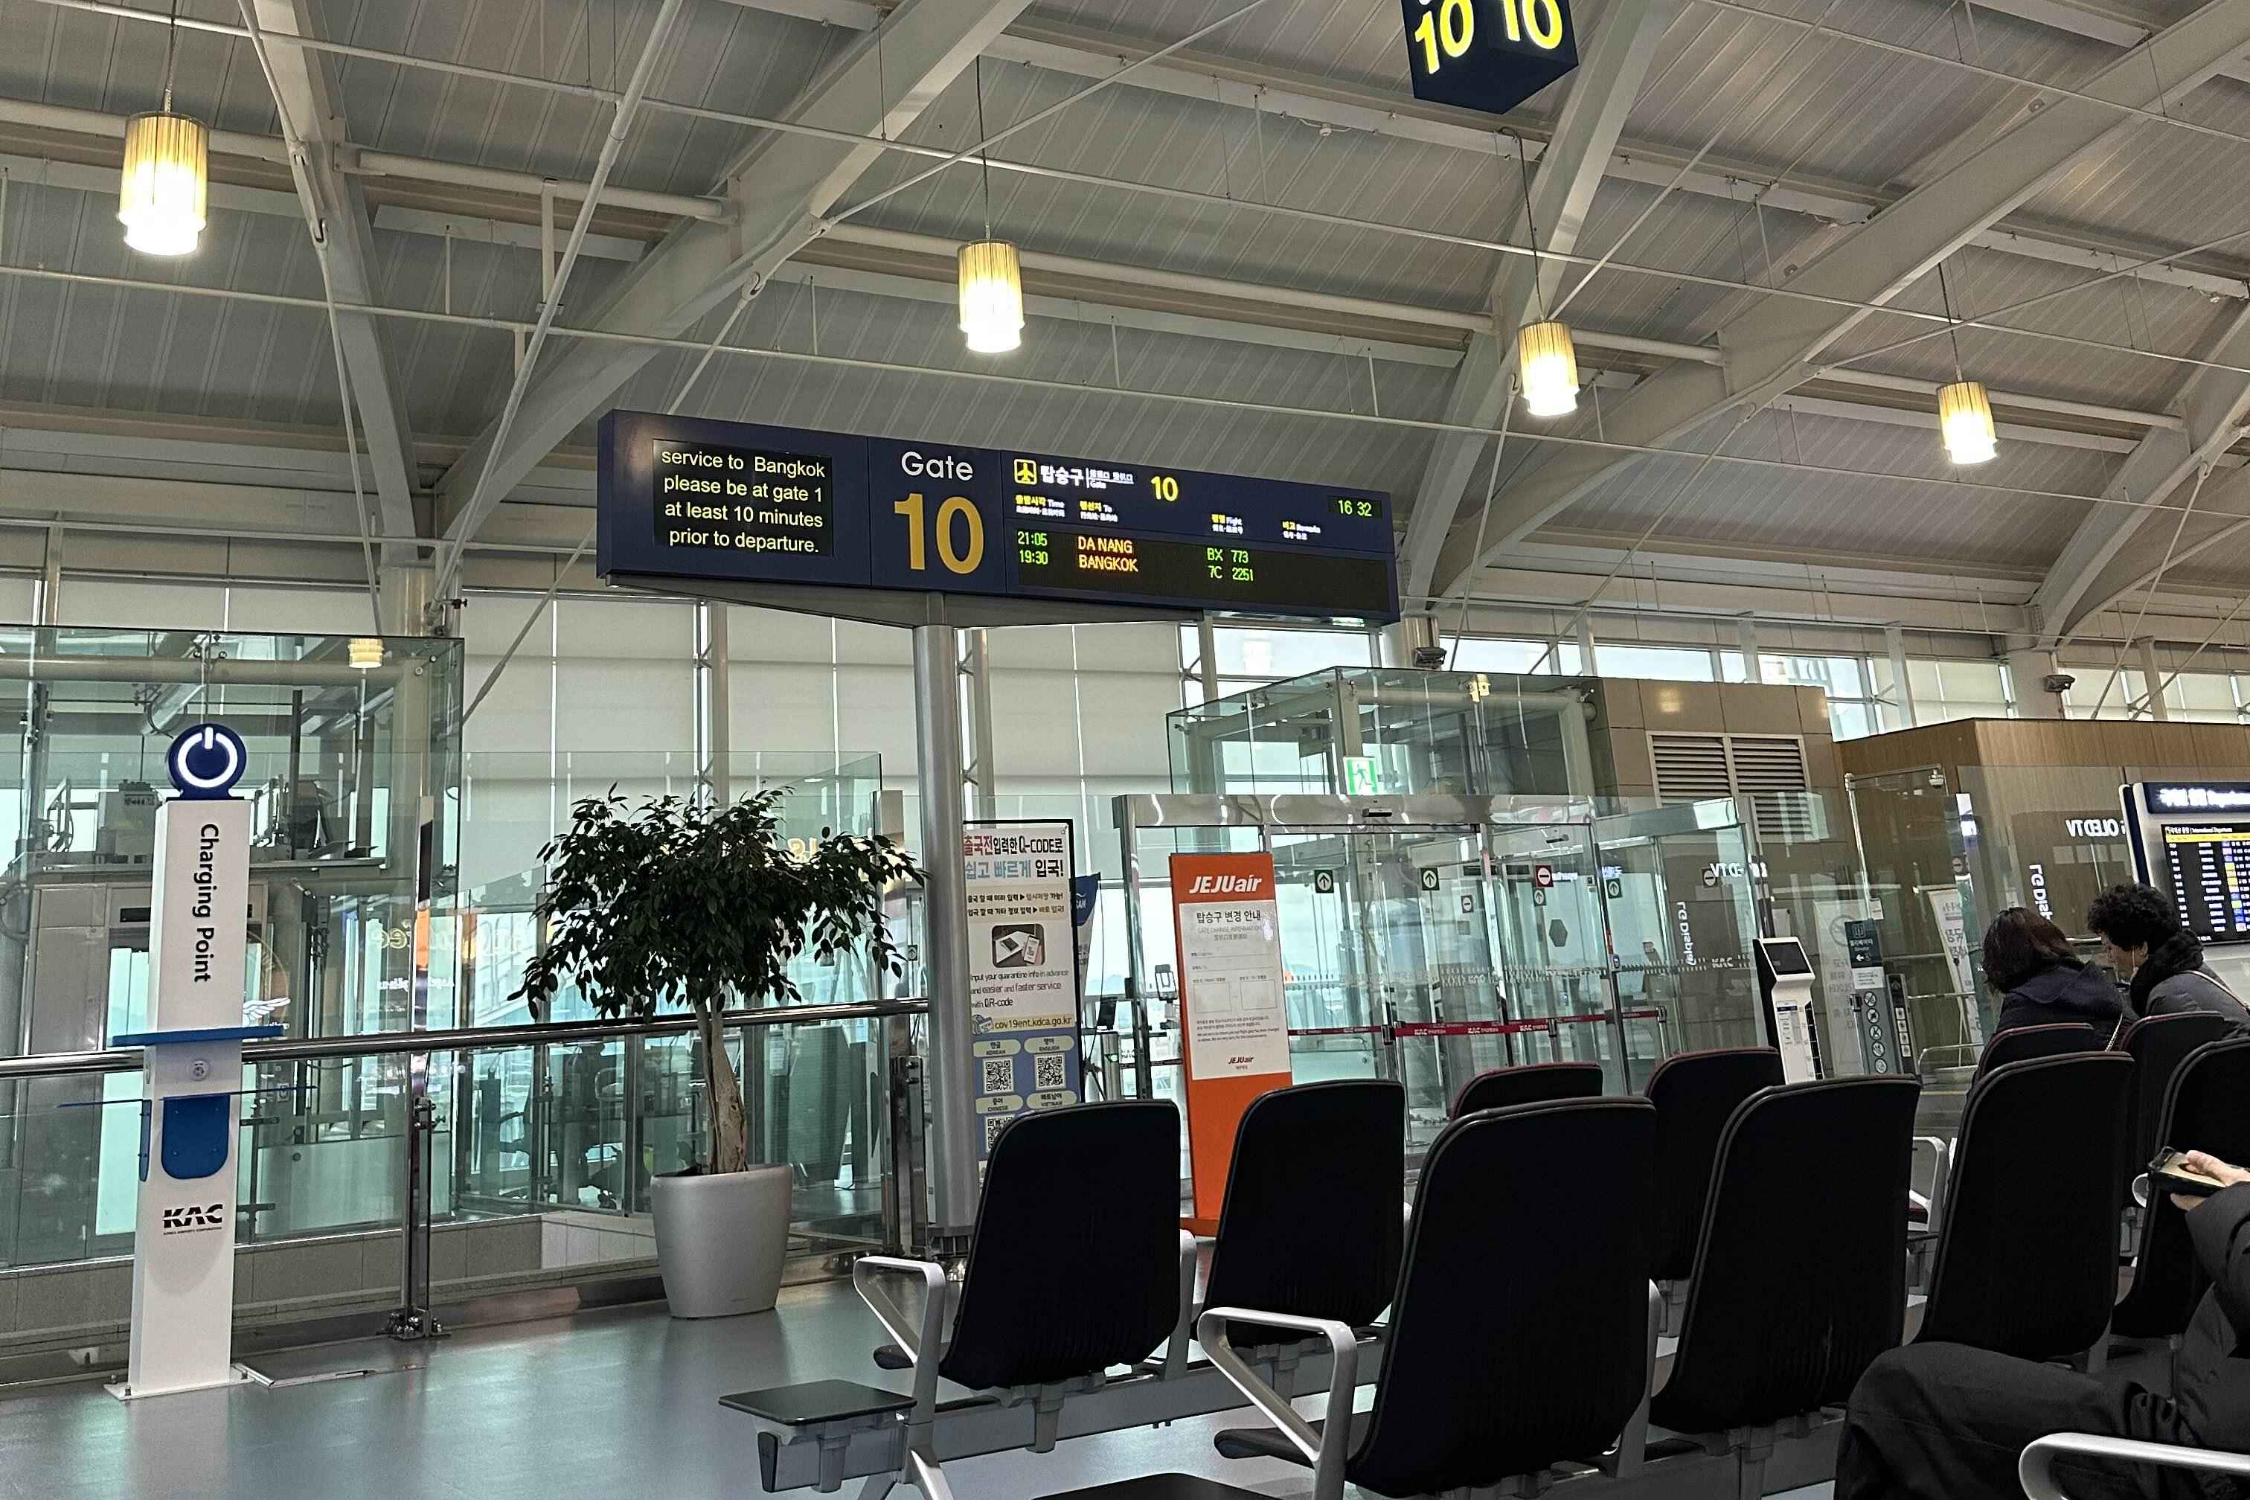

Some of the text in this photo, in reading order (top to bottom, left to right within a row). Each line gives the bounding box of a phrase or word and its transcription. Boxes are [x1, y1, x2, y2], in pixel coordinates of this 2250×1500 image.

[1414, 0, 1475, 74] 10
[661, 451, 826, 479] service to Bangkok
[901, 451, 974, 481] Gate
[1040, 465, 1084, 486] 탑승구
[664, 475, 822, 502] please be at gate 1
[1150, 476, 1179, 502] 10
[665, 502, 823, 528] at least 10 minutes
[1103, 505, 1113, 513] To
[669, 528, 819, 552] prior to departure.
[894, 493, 984, 575] 10
[1017, 531, 1249, 563] 21:05 DA NANG BX 773
[1019, 550, 1254, 581] 19:30 BANGKOK 7C 2251
[993, 837, 1017, 854] 입력한
[965, 860, 1064, 880] 쉽고 빠르게 입국!
[1189, 874, 1263, 894] JEJUair
[192, 823, 220, 983] Charging Point
[1196, 909, 1261, 924] 탑승구 변경 안내
[162, 1204, 223, 1228] KAC
